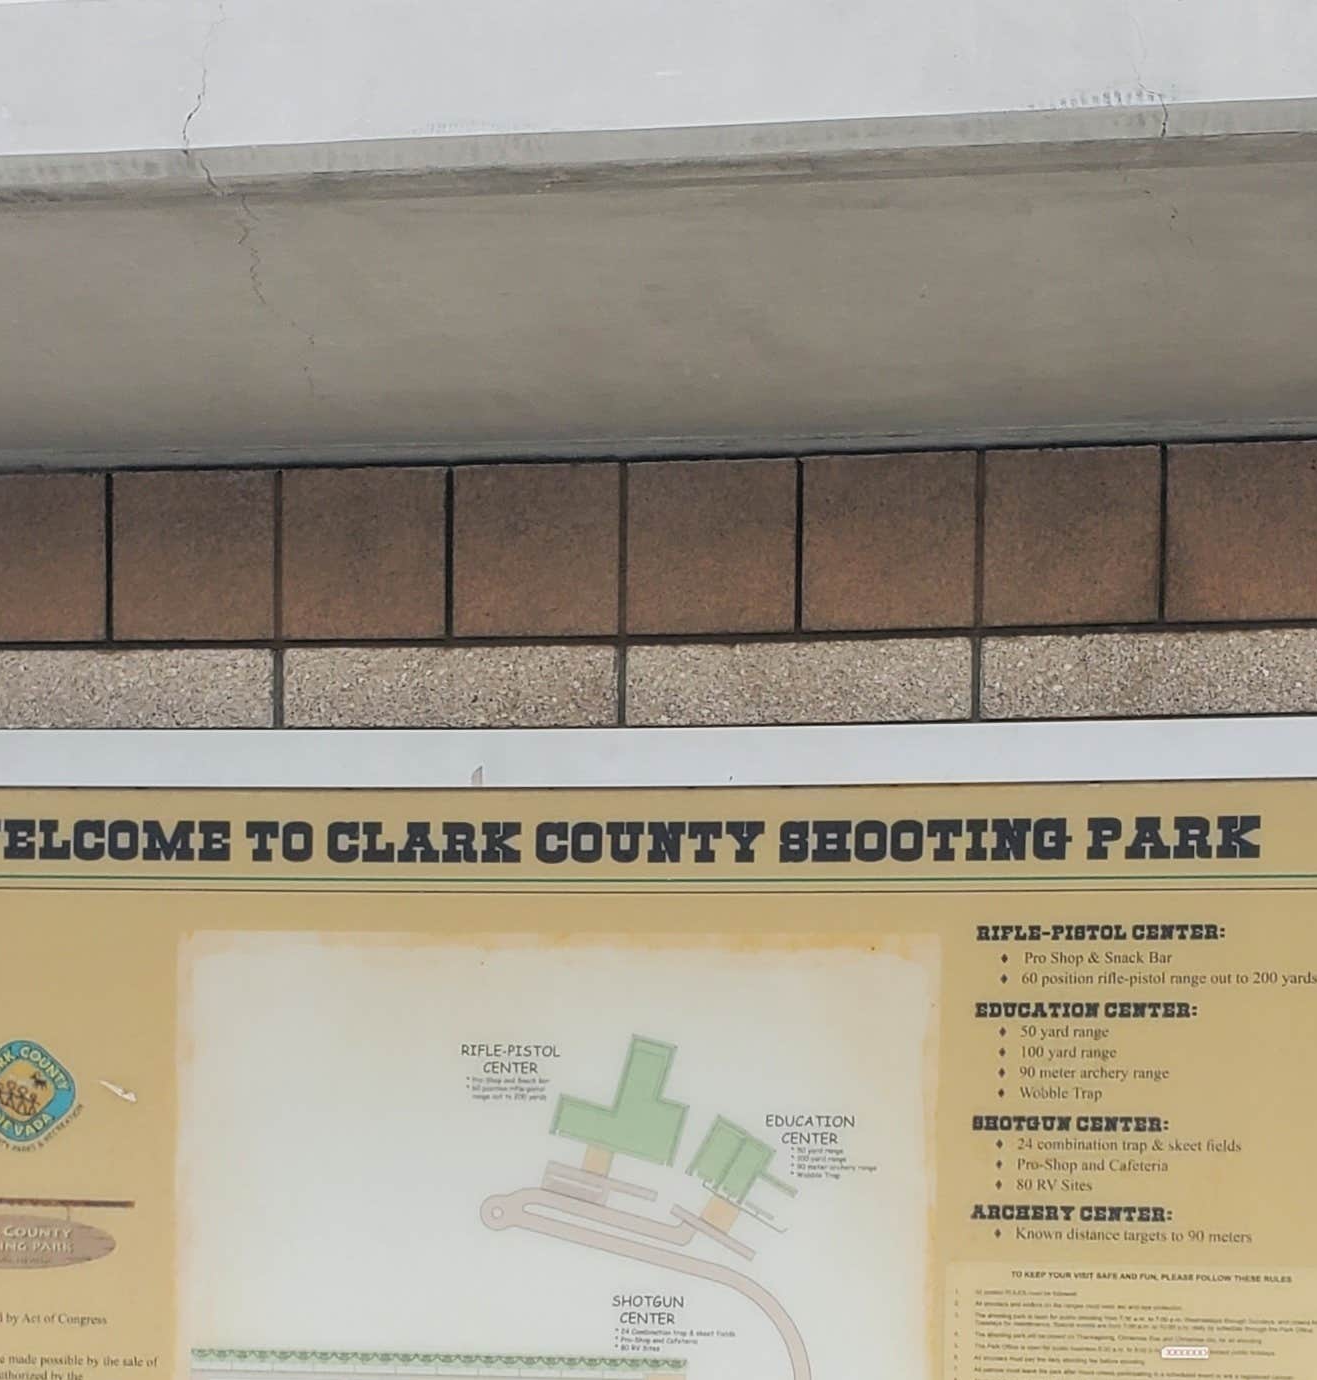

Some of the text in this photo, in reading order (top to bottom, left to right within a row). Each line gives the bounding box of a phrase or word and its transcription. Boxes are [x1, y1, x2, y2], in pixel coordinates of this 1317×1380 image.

[245, 821, 312, 862] TO
[327, 821, 522, 864] CLARK
[535, 821, 764, 864] COUNTY
[780, 818, 1072, 862] SHOOTING
[1087, 815, 1261, 859] PARK
[976, 925, 1226, 941] RIFLE-PISTOL CENTER:
[1024, 951, 1172, 967] Pro Shop & Snack Bar
[975, 1003, 1198, 1018] EDUCATION CENTER:
[461, 1044, 561, 1058] RIFLE-PISTOL
[20, 1047, 70, 1091] COUNTY
[482, 1061, 538, 1075] CENTER
[1020, 1086, 1102, 1102] Wobble Trap
[765, 1114, 855, 1128] EDUCATION
[972, 1116, 1169, 1132] SHOTGUN CENTER:
[781, 1132, 838, 1145] CENTER
[970, 1204, 1173, 1222] ARCHERY CENTER:
[3, 1225, 72, 1238] COUNTY
[1016, 1228, 1252, 1245] Known distance targets to 90 meters
[32, 1240, 73, 1252] PARK
[612, 1295, 684, 1309] SHOTGUN
[619, 1312, 676, 1325] CENTER
